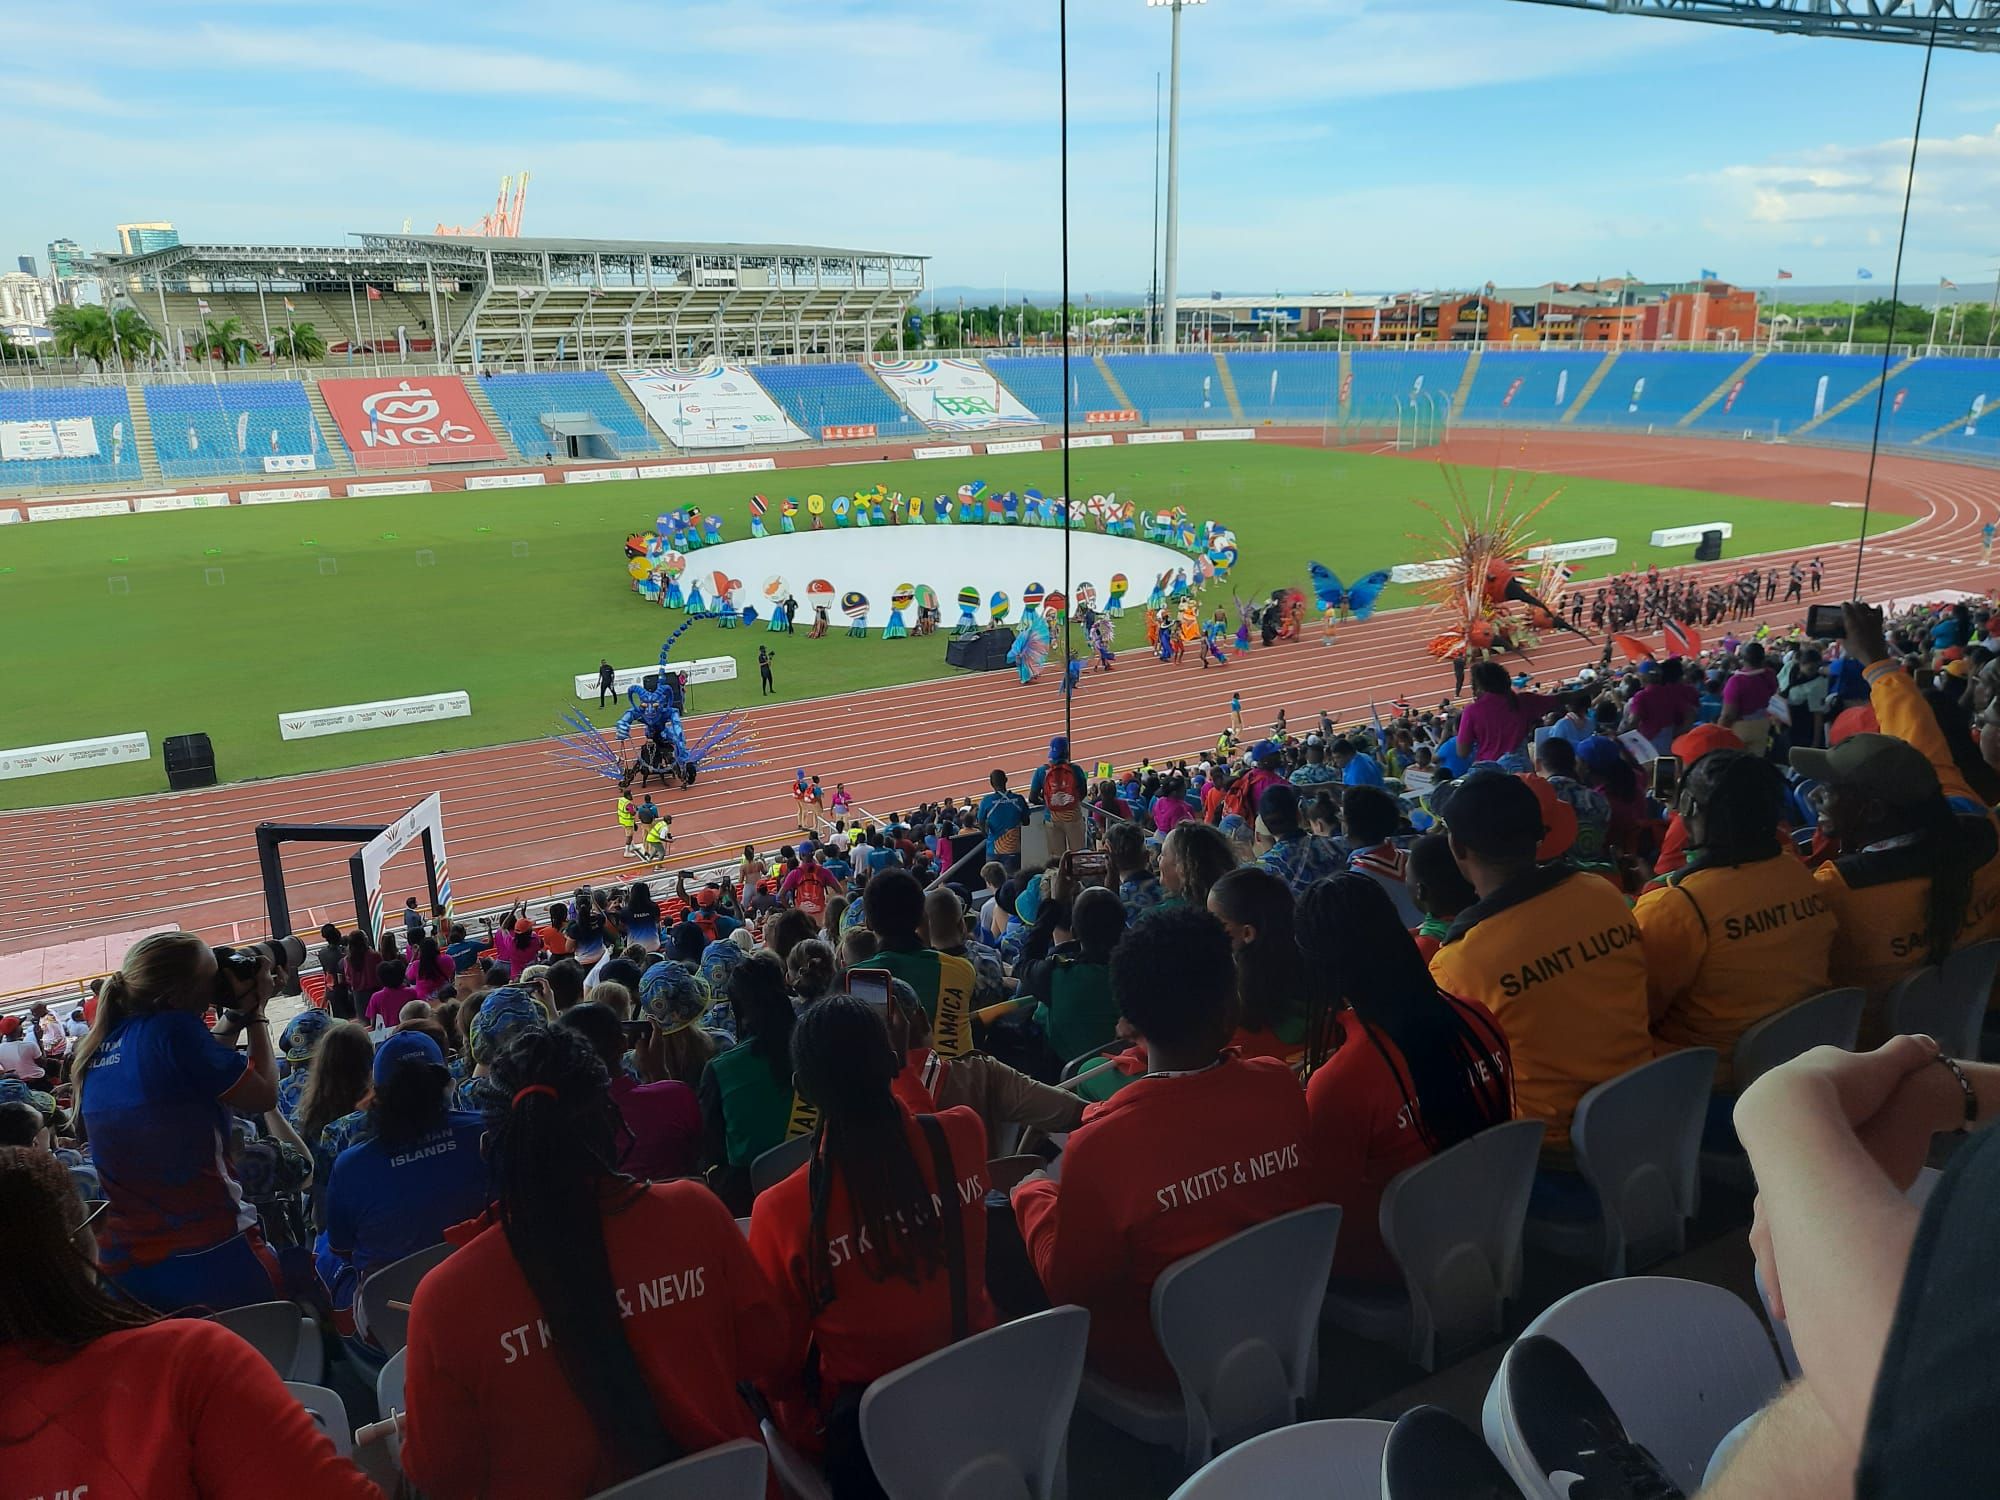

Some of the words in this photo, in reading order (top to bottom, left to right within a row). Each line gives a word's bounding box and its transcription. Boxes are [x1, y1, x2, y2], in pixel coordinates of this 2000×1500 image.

[360, 426, 476, 447] NGC
[1725, 903, 1788, 940] SAINT
[1790, 894, 1825, 921] LUC
[1499, 946, 1575, 997] SAINT
[390, 1140, 457, 1168] ISLANDS
[1156, 1183, 1179, 1213] ST
[1180, 1166, 1228, 1205] KITTS
[1233, 1161, 1247, 1185] &
[1249, 1143, 1300, 1181] NEVIS
[828, 1234, 849, 1267] ST
[500, 1324, 531, 1364] ST
[615, 1288, 636, 1320] &
[638, 1266, 706, 1313] NEVIS
